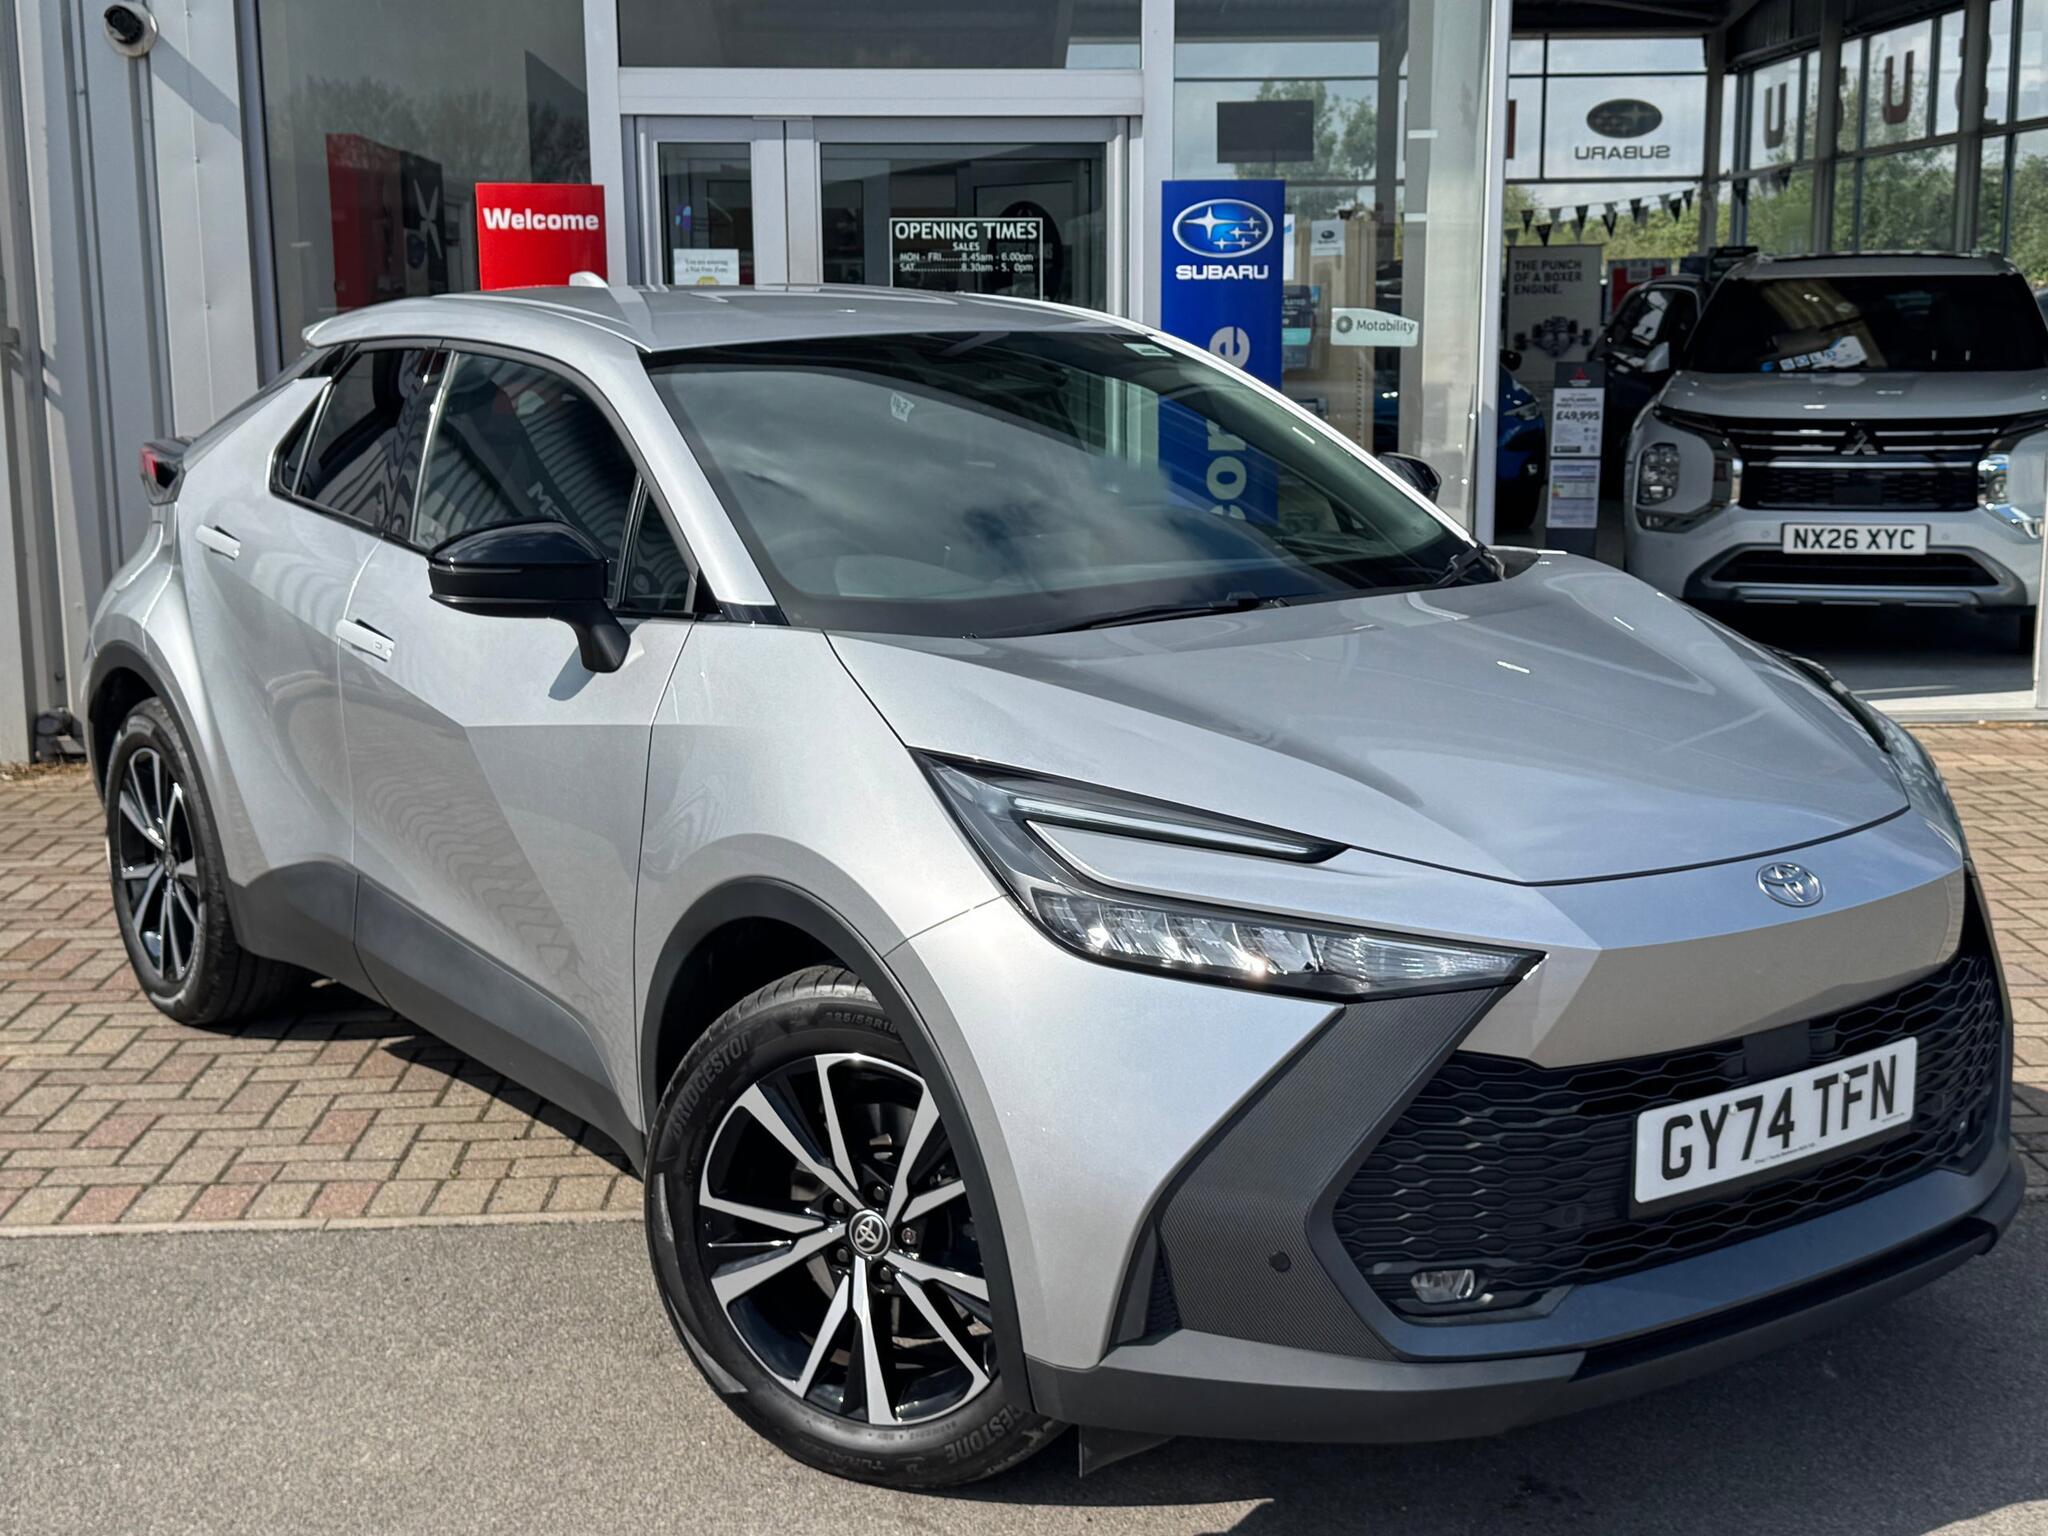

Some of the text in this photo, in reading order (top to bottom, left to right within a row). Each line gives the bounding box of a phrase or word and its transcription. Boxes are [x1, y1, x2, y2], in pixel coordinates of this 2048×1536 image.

[482, 207, 599, 230] Welcome
[895, 222, 1038, 240] OPENING TIMES
[952, 242, 980, 251] SALES
[899, 252, 920, 262] MON
[1514, 259, 1582, 270] THE PUNCH
[1175, 264, 1269, 280] SUBARU
[1513, 271, 1582, 282] OF A BOXER
[1513, 283, 1563, 295] ENGINE.
[1556, 410, 1600, 422] £49,995
[1793, 527, 1916, 550] NX26 XYC
[1661, 1054, 1897, 1181] GY74 TFN
